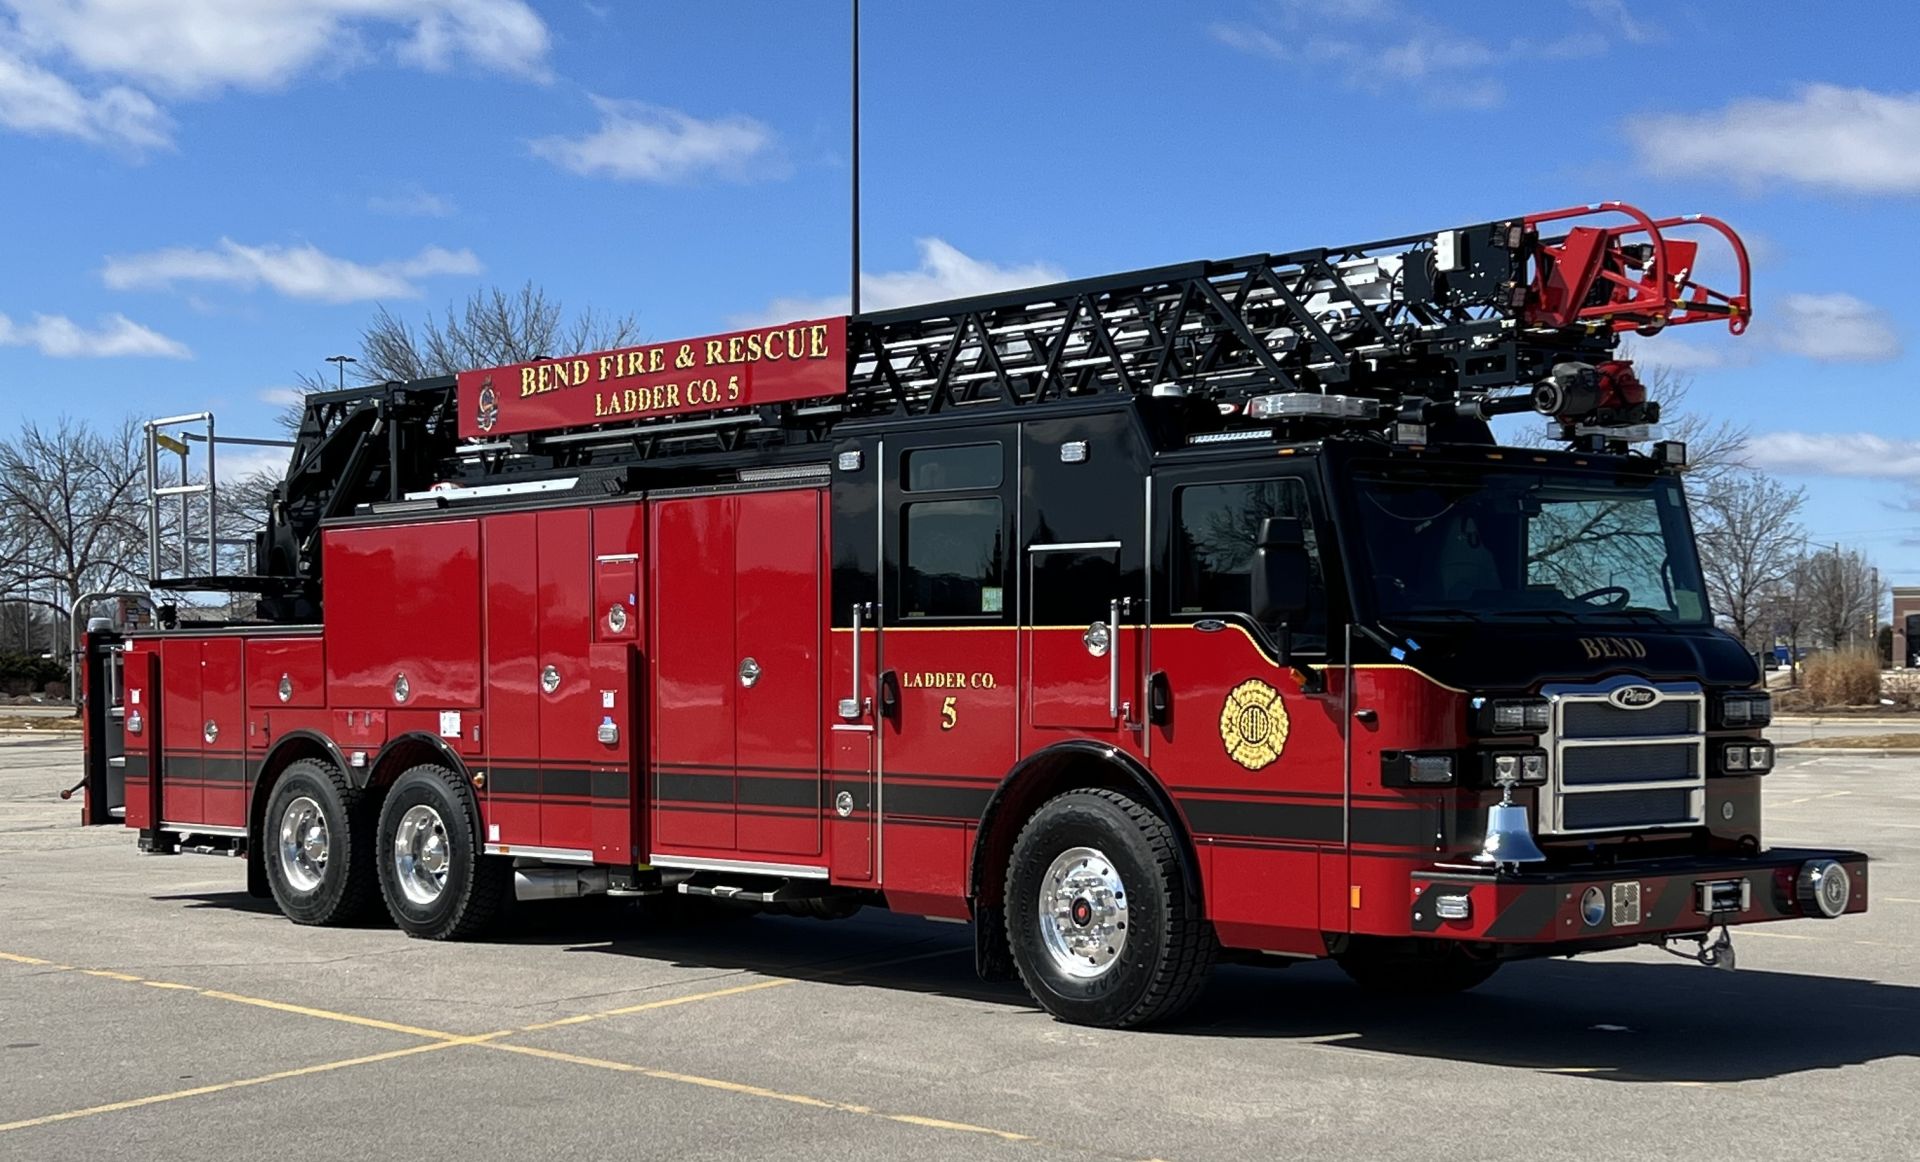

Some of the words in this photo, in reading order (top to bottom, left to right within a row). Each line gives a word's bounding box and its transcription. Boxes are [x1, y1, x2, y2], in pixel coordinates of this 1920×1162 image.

[520, 359, 590, 397] BEND
[598, 347, 666, 381] FIRE
[675, 344, 696, 369] &
[705, 324, 829, 365] RESCUE
[595, 383, 681, 416] LADDER
[686, 378, 722, 405] CO.
[727, 375, 739, 400] 5
[1578, 637, 1647, 659] BEND
[903, 672, 967, 688] LADDER
[970, 672, 997, 689] CO.
[942, 696, 957, 729] 5
